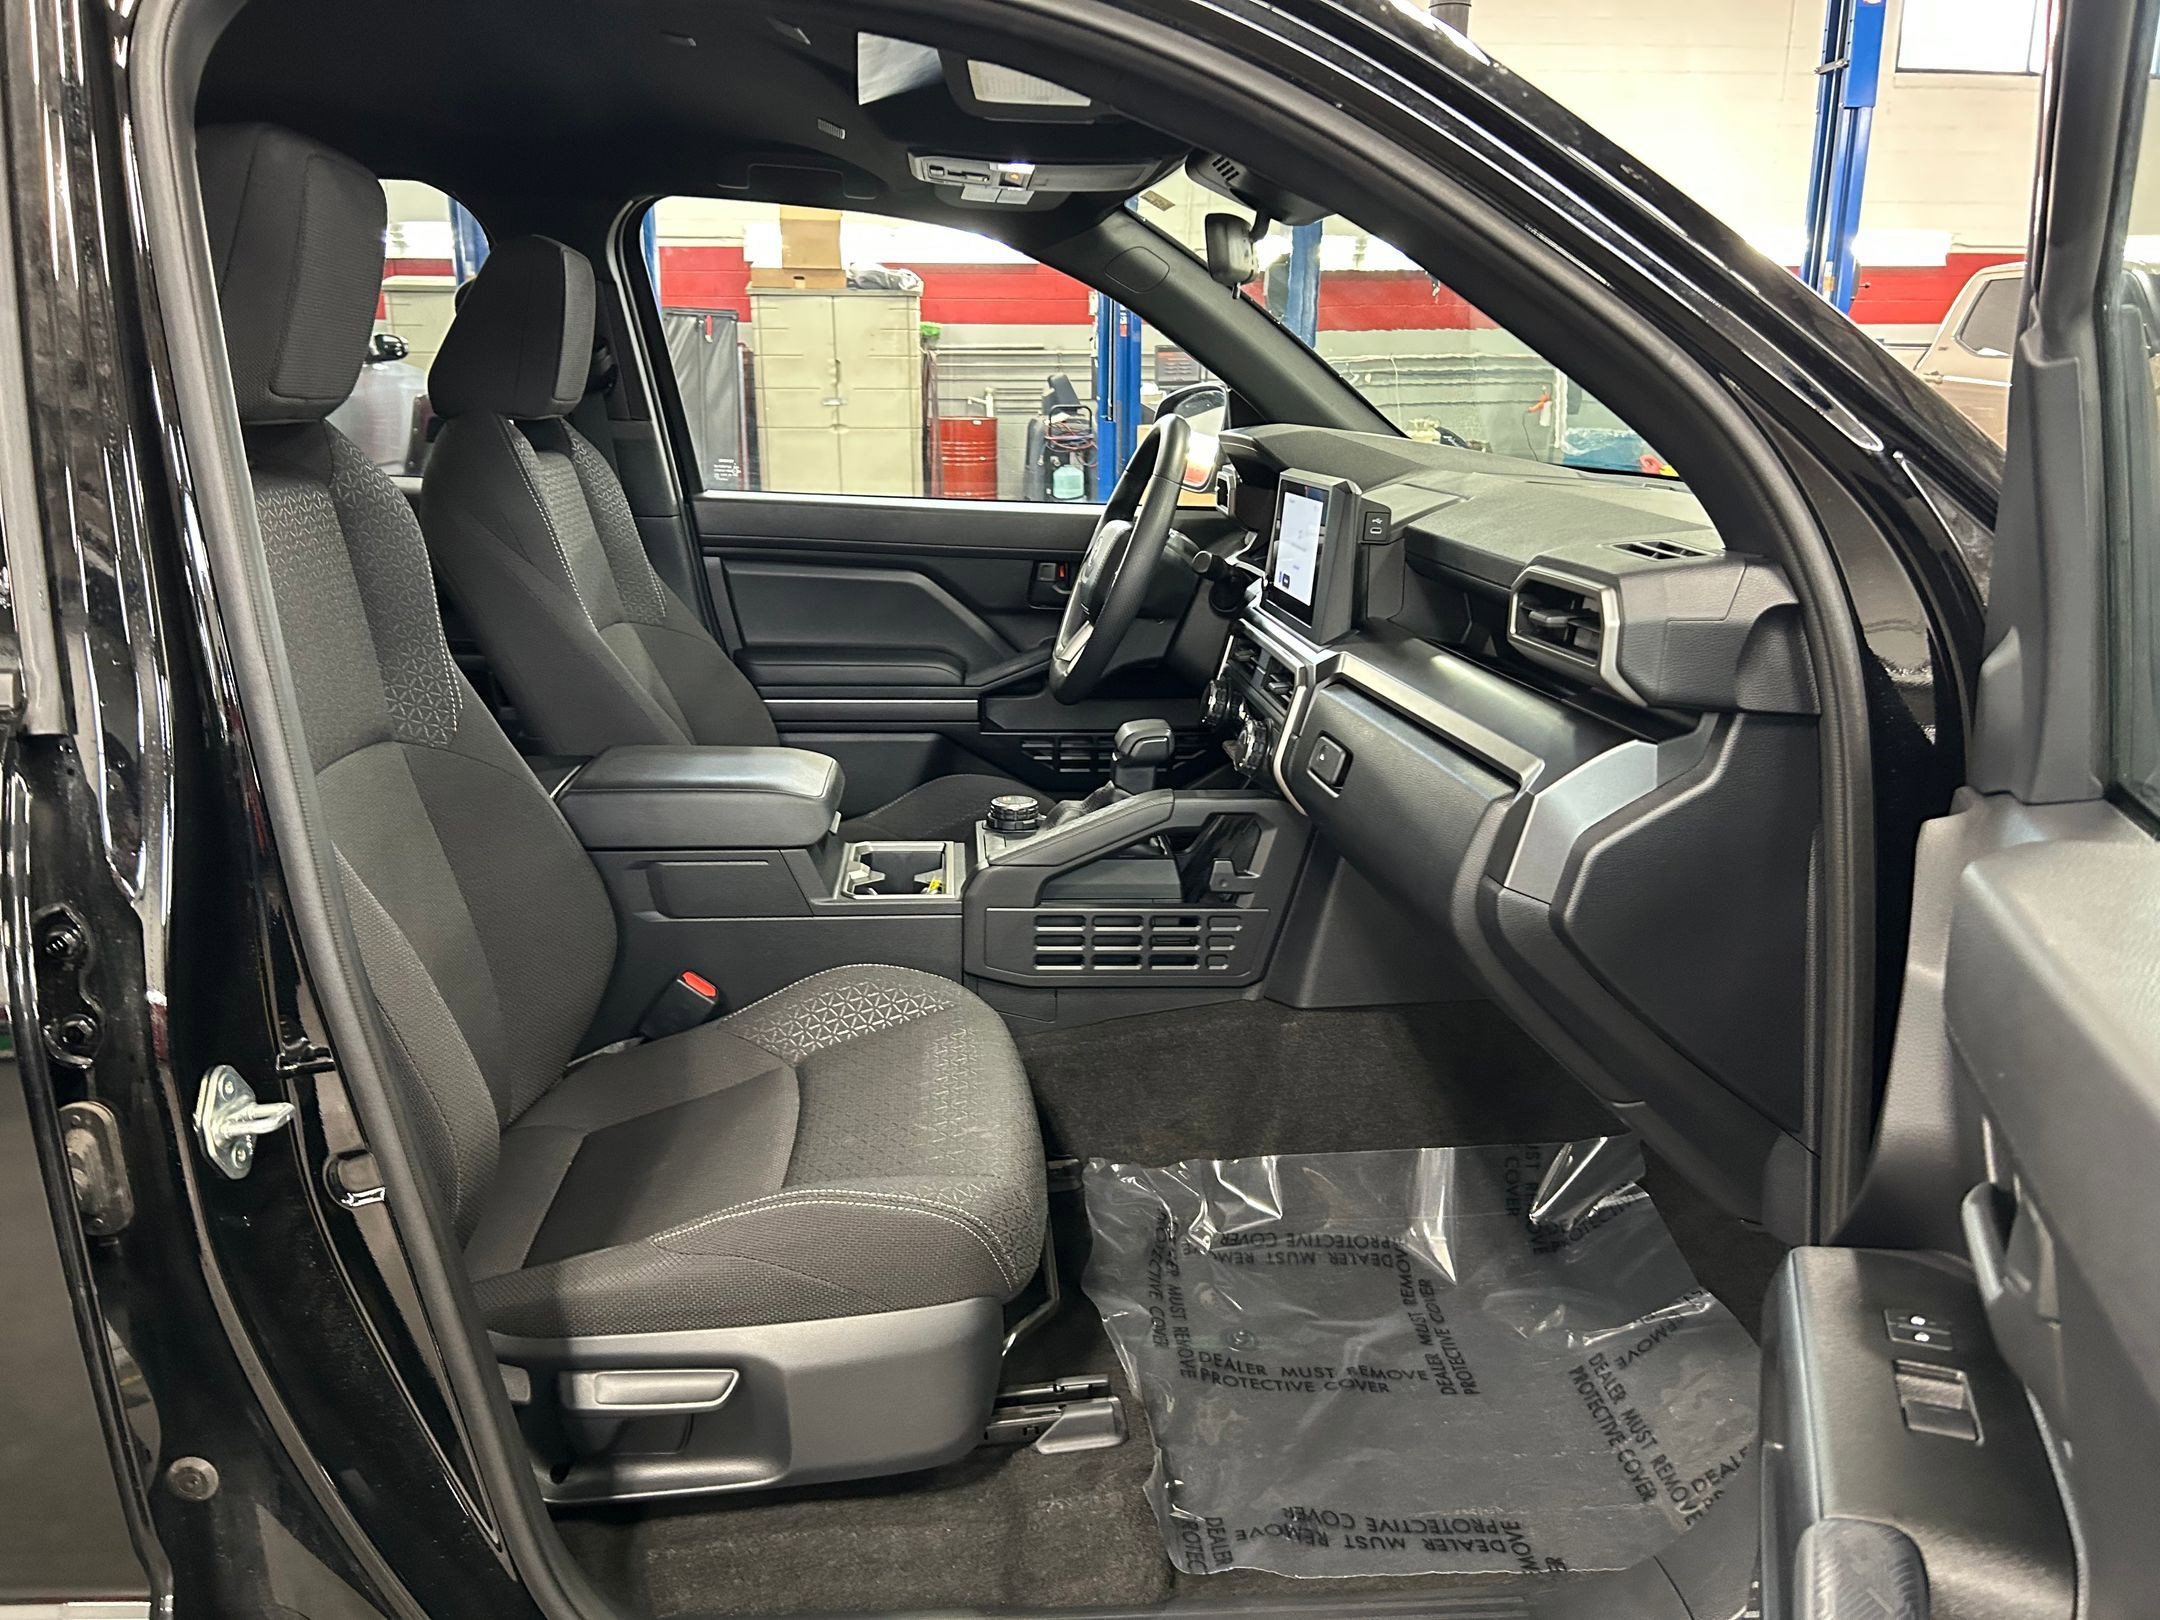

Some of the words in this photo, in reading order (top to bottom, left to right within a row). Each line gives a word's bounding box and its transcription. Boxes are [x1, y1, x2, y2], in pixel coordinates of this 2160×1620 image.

[1220, 1232, 1278, 1248] COVER
[1286, 1232, 1391, 1249] PROTECTIVE
[1265, 1250, 1316, 1265] MUST
[1327, 1251, 1395, 1268] DEALER
[1167, 1284, 1187, 1321] MUST
[1418, 1278, 1445, 1324] COVER
[1149, 1305, 1169, 1349] COVER
[1408, 1312, 1434, 1346] MUST
[1173, 1326, 1197, 1378] REMOVE
[1198, 1350, 1268, 1376] DEALER
[1280, 1366, 1336, 1380] MUST
[1434, 1327, 1481, 1395] PROTECTIVE
[1200, 1367, 1316, 1393] PROTECTIVE
[1323, 1378, 1391, 1393] COVER
[1424, 1352, 1457, 1395] DEALER
[1568, 1364, 1627, 1447] PROTECTIVE
[1617, 1448, 1658, 1503] COVER
[1588, 1352, 1627, 1405] DEALER
[1620, 1407, 1659, 1451] MUST
[1650, 1453, 1704, 1527] REMOVE
[1282, 1505, 1358, 1530] COVER
[1366, 1516, 1499, 1536] PROTECTIVE
[1204, 1516, 1234, 1567] DEALER
[1234, 1523, 1330, 1548] REMOVE
[1343, 1534, 1407, 1551] MUST
[1424, 1536, 1507, 1553] DEALER
